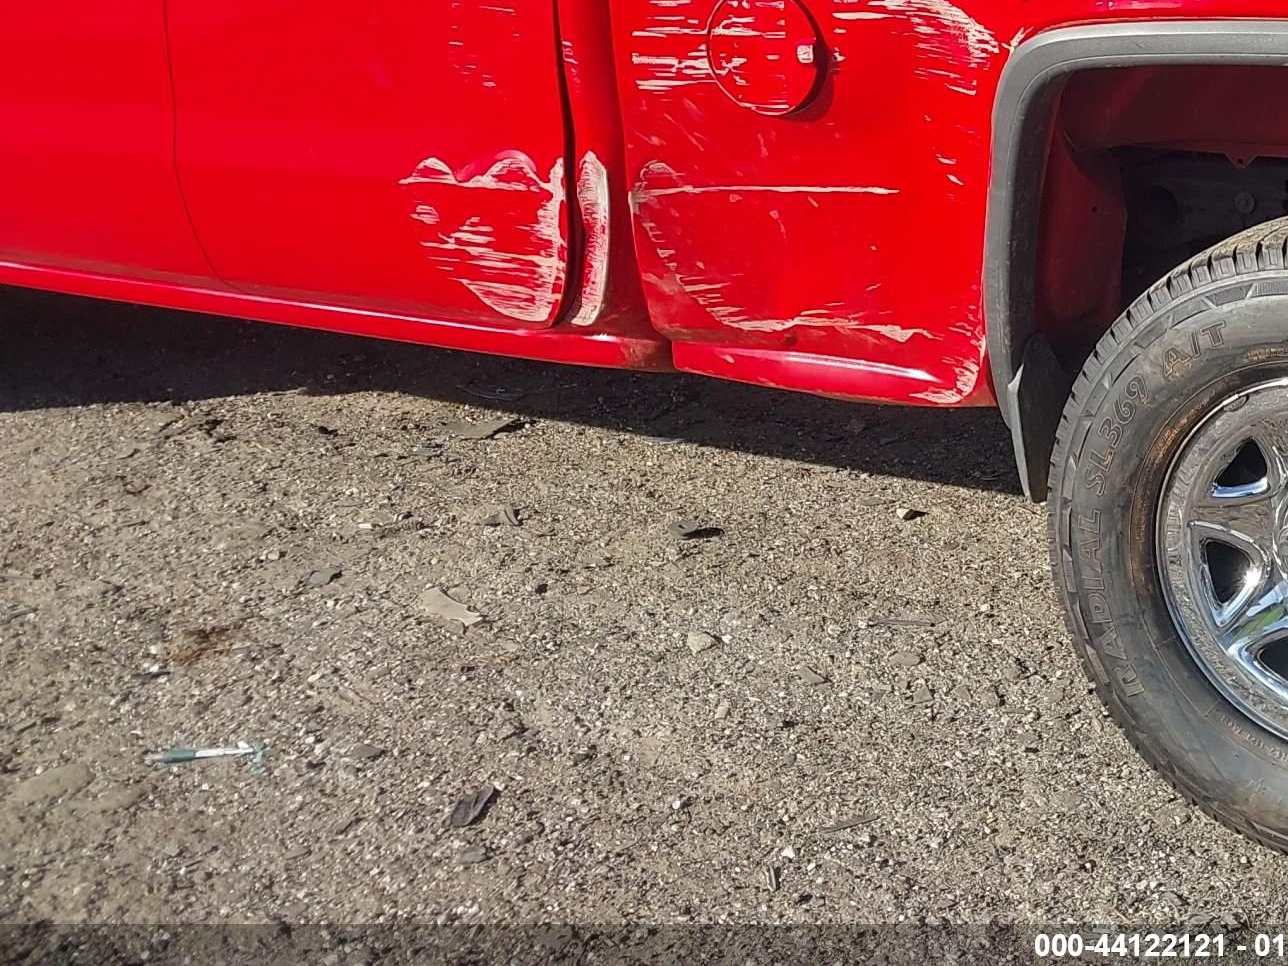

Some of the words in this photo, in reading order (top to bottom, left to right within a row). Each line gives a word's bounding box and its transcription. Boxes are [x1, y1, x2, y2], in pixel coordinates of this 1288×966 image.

[1162, 320, 1227, 379] A/T
[1086, 375, 1149, 497] SL369
[1078, 509, 1145, 698] RADIAL
